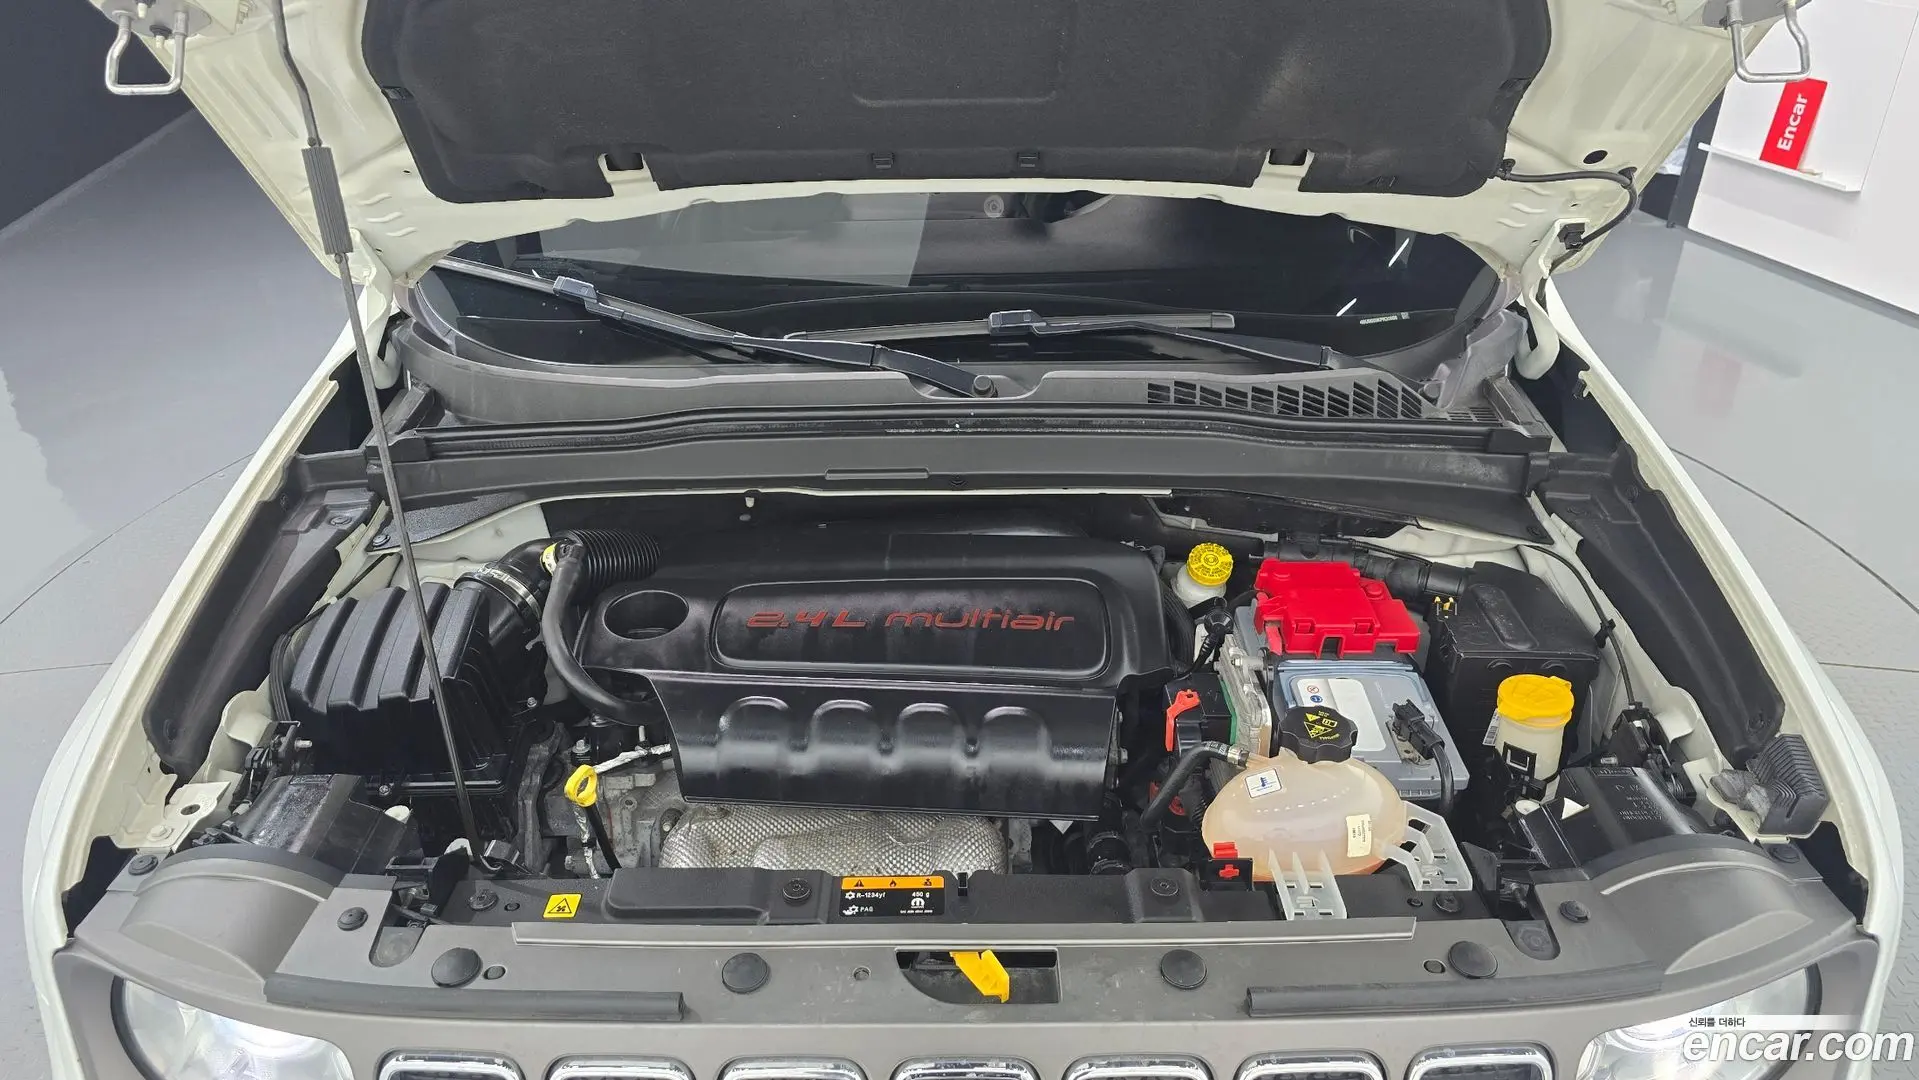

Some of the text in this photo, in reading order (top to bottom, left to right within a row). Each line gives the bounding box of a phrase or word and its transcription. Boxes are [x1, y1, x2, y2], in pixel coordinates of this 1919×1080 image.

[1776, 92, 1808, 151] Encar
[746, 608, 1075, 631] 2.4L multiair
[856, 891, 886, 899] R-1234yf
